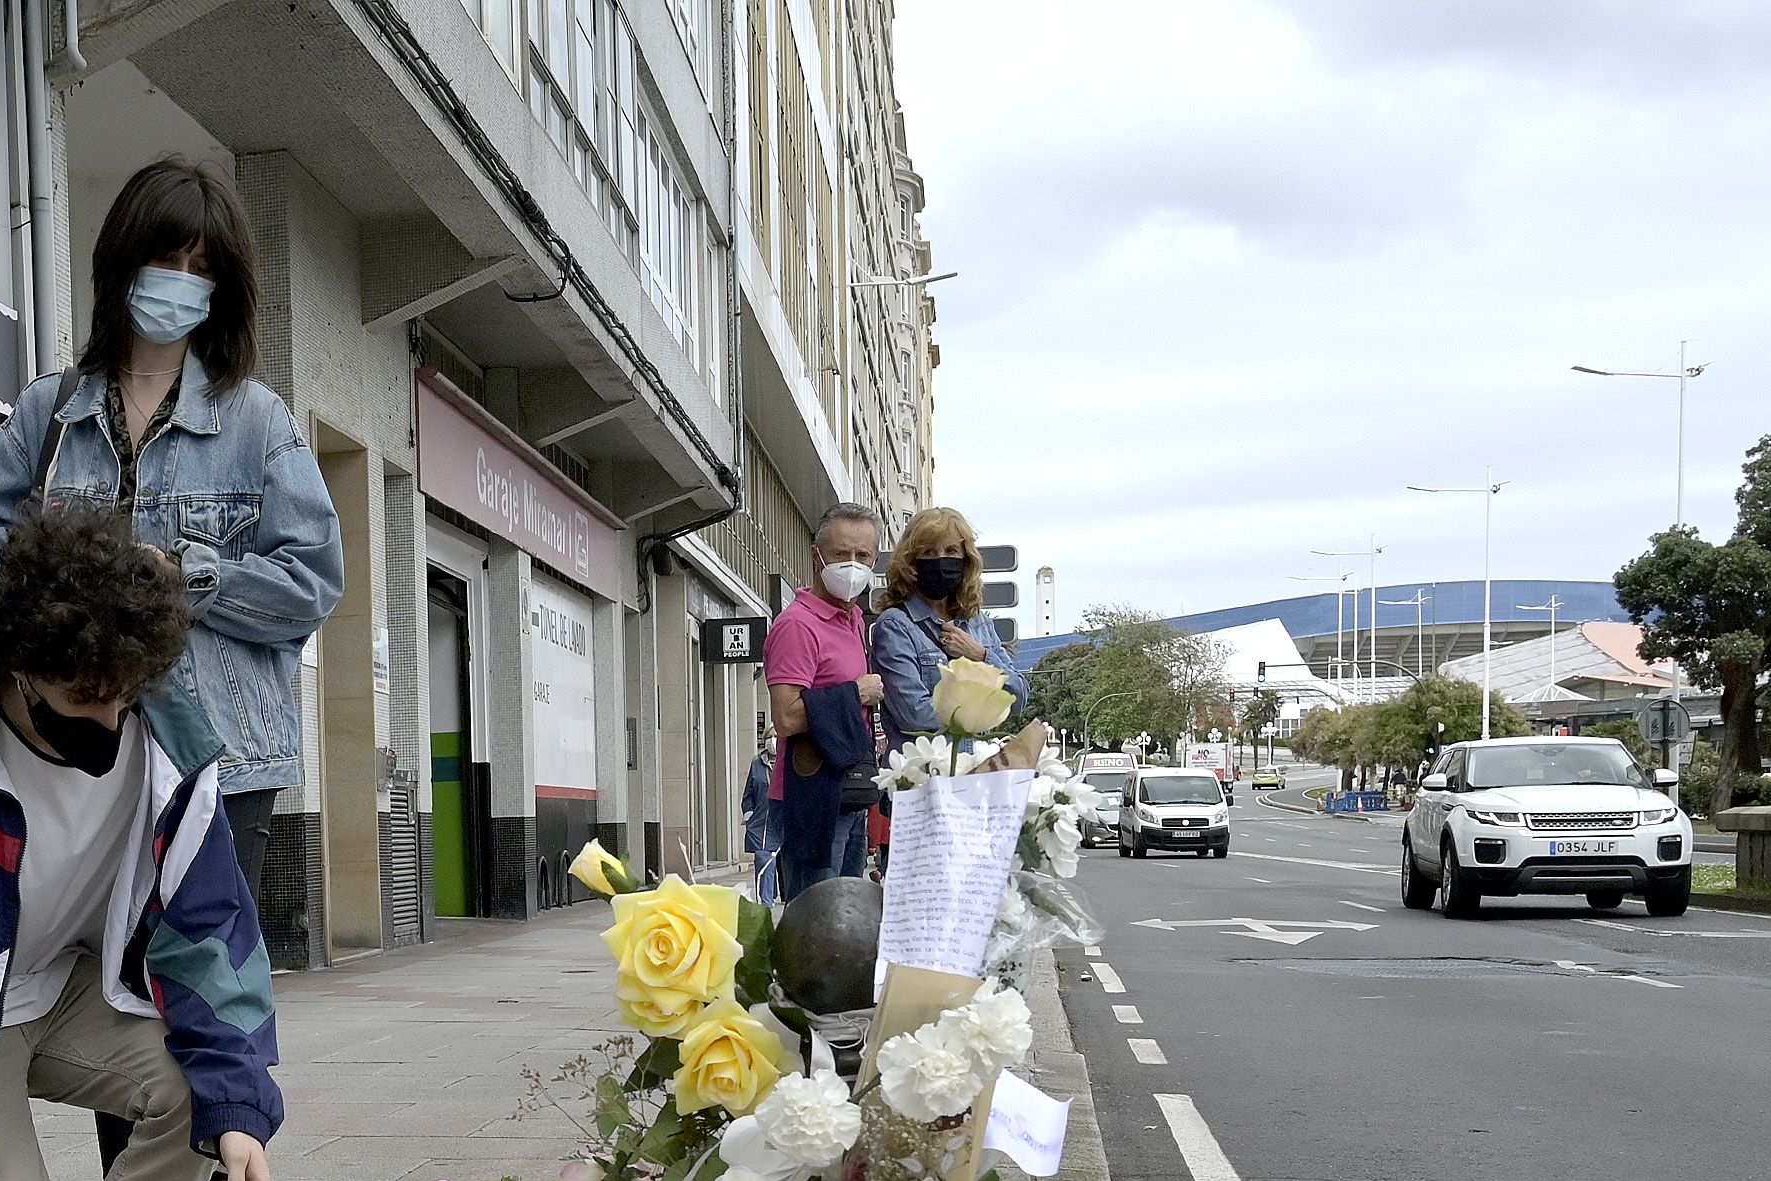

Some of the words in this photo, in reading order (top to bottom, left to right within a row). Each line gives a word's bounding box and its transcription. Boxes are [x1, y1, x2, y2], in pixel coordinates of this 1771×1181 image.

[476, 447, 519, 533] Garaje
[523, 479, 566, 555] Miramar
[729, 627, 744, 635] UR
[533, 680, 550, 705] GARAJE
[1557, 842, 1588, 853] 0354
[1593, 842, 1616, 853] JLF
